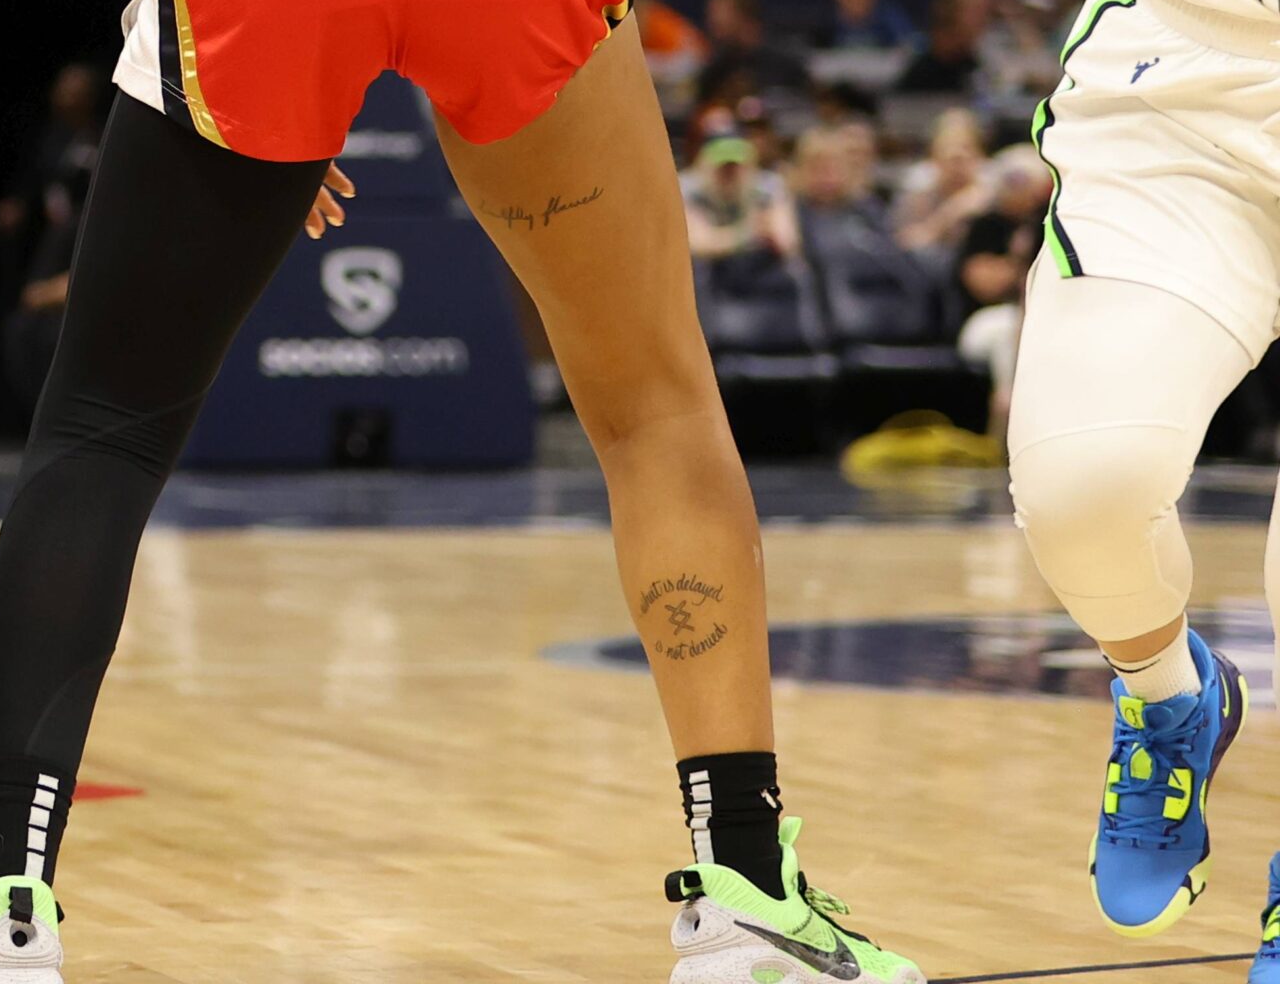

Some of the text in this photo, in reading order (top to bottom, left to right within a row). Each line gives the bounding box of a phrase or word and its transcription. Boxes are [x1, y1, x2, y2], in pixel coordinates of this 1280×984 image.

[676, 572, 724, 606] delayed
[666, 642, 689, 661] not
[688, 622, 728, 658] denied
